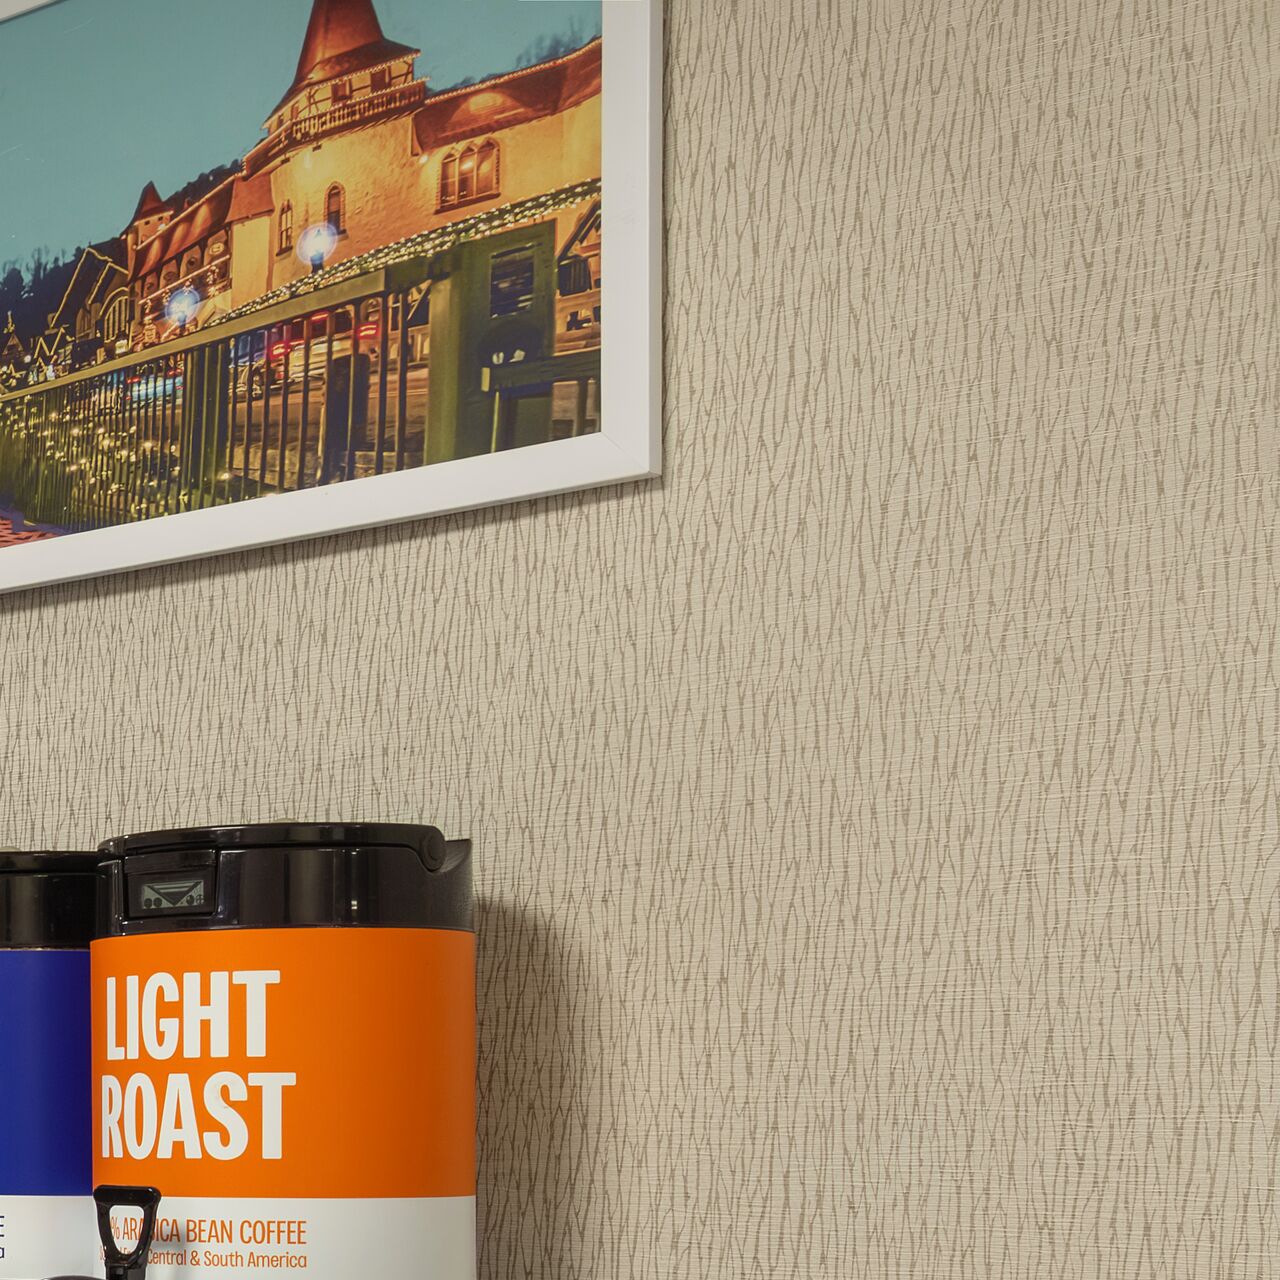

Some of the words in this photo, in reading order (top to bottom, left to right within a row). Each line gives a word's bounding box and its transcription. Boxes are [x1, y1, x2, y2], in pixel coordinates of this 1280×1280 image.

[106, 969, 281, 1061] LIGHT
[101, 1071, 297, 1160] ROAST
[147, 1249, 187, 1266] Central
[190, 1250, 200, 1266] &
[203, 1250, 243, 1267] South
[247, 1251, 307, 1268] America
[186, 1218, 233, 1243] BEAN
[239, 1220, 307, 1245] COFFEE
